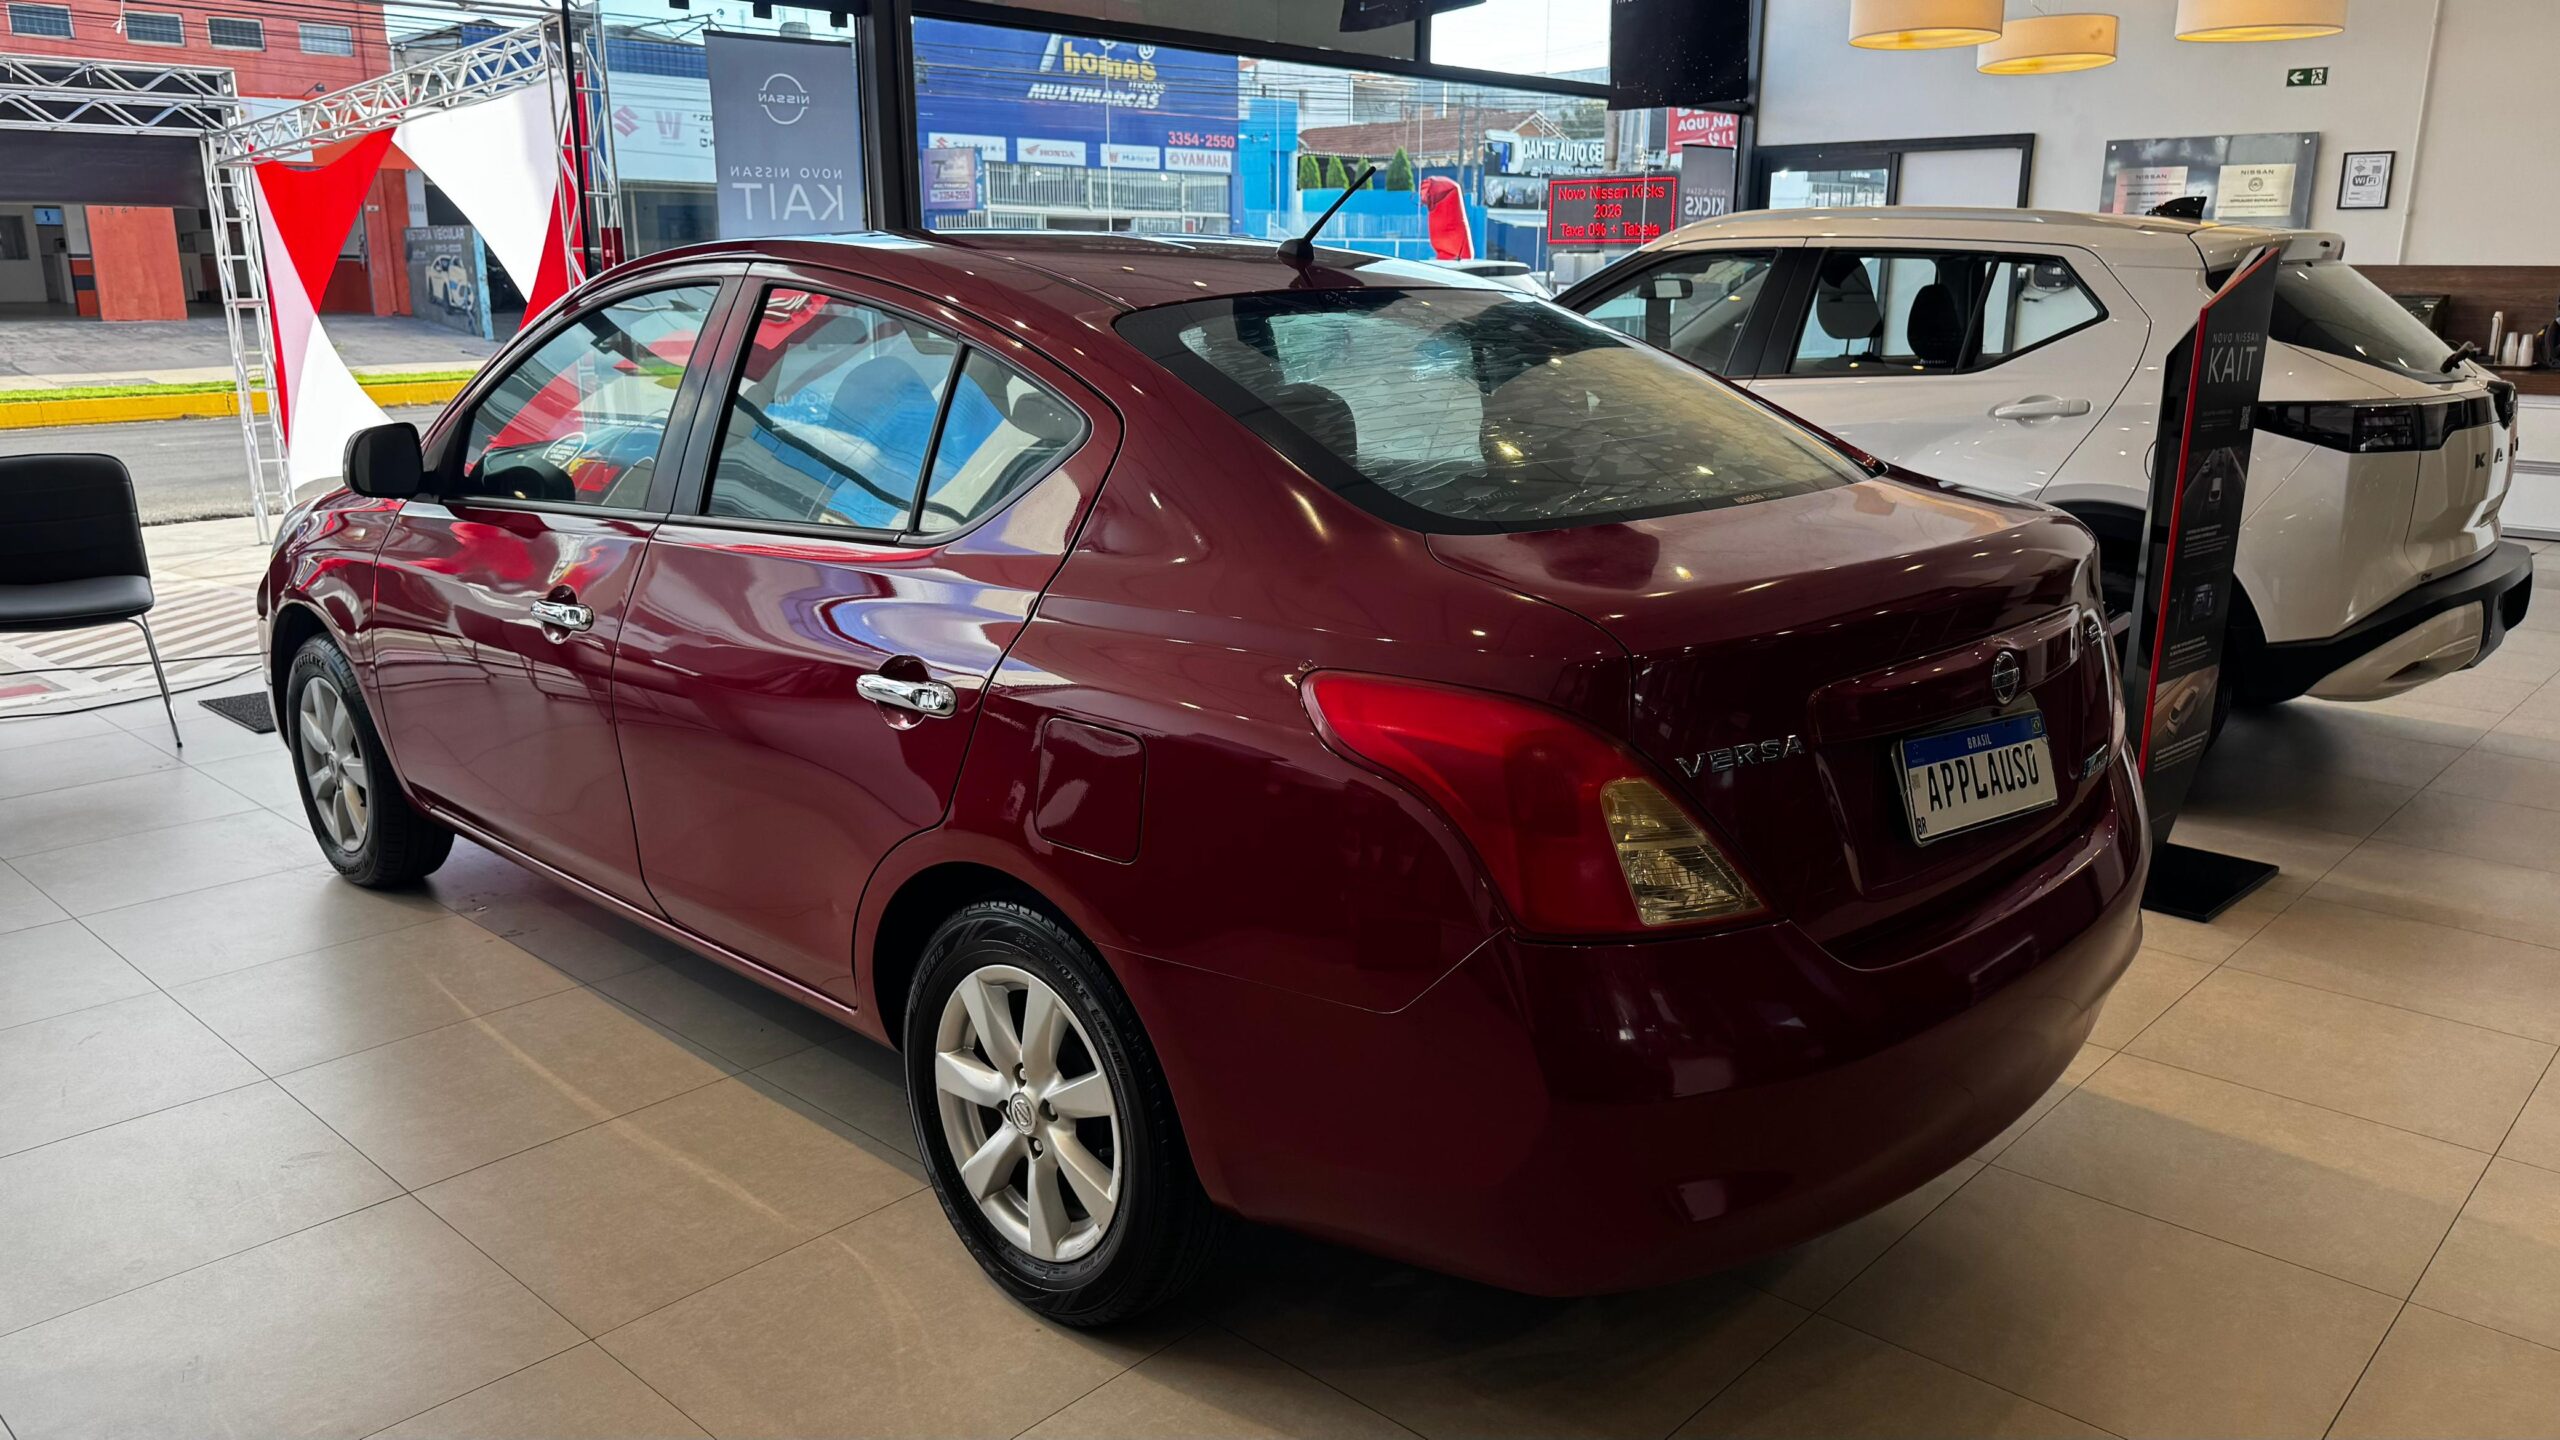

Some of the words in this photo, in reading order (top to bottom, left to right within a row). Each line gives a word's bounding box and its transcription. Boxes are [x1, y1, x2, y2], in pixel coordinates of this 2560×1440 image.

[1027, 83, 1161, 109] MULTIMARCAS
[1677, 117, 1709, 132] AQUI
[1713, 114, 1734, 128] NA
[1168, 131, 1235, 149] 3354-2550
[1040, 149, 1076, 158] HONDA
[1523, 139, 1557, 160] DANTE
[1558, 142, 1587, 162] AUTO
[1182, 152, 1229, 168] YAMAHA
[1558, 186, 1586, 200] Novo
[1589, 186, 1628, 200] Nissan
[1632, 184, 1665, 199] Kicks
[1593, 204, 1622, 219] 2026
[1560, 223, 1585, 237] Taxa
[1587, 222, 1607, 237] 0%
[1622, 222, 1660, 237] Tabela
[2213, 332, 2233, 344] NOVO
[2236, 331, 2260, 343] NISSAN
[2207, 346, 2258, 384] KAIT
[1966, 733, 1993, 750] BRASIL
[1674, 734, 1806, 778] VERSA
[1926, 743, 2040, 812] APPLAUSO
[1916, 816, 1928, 836] BR
